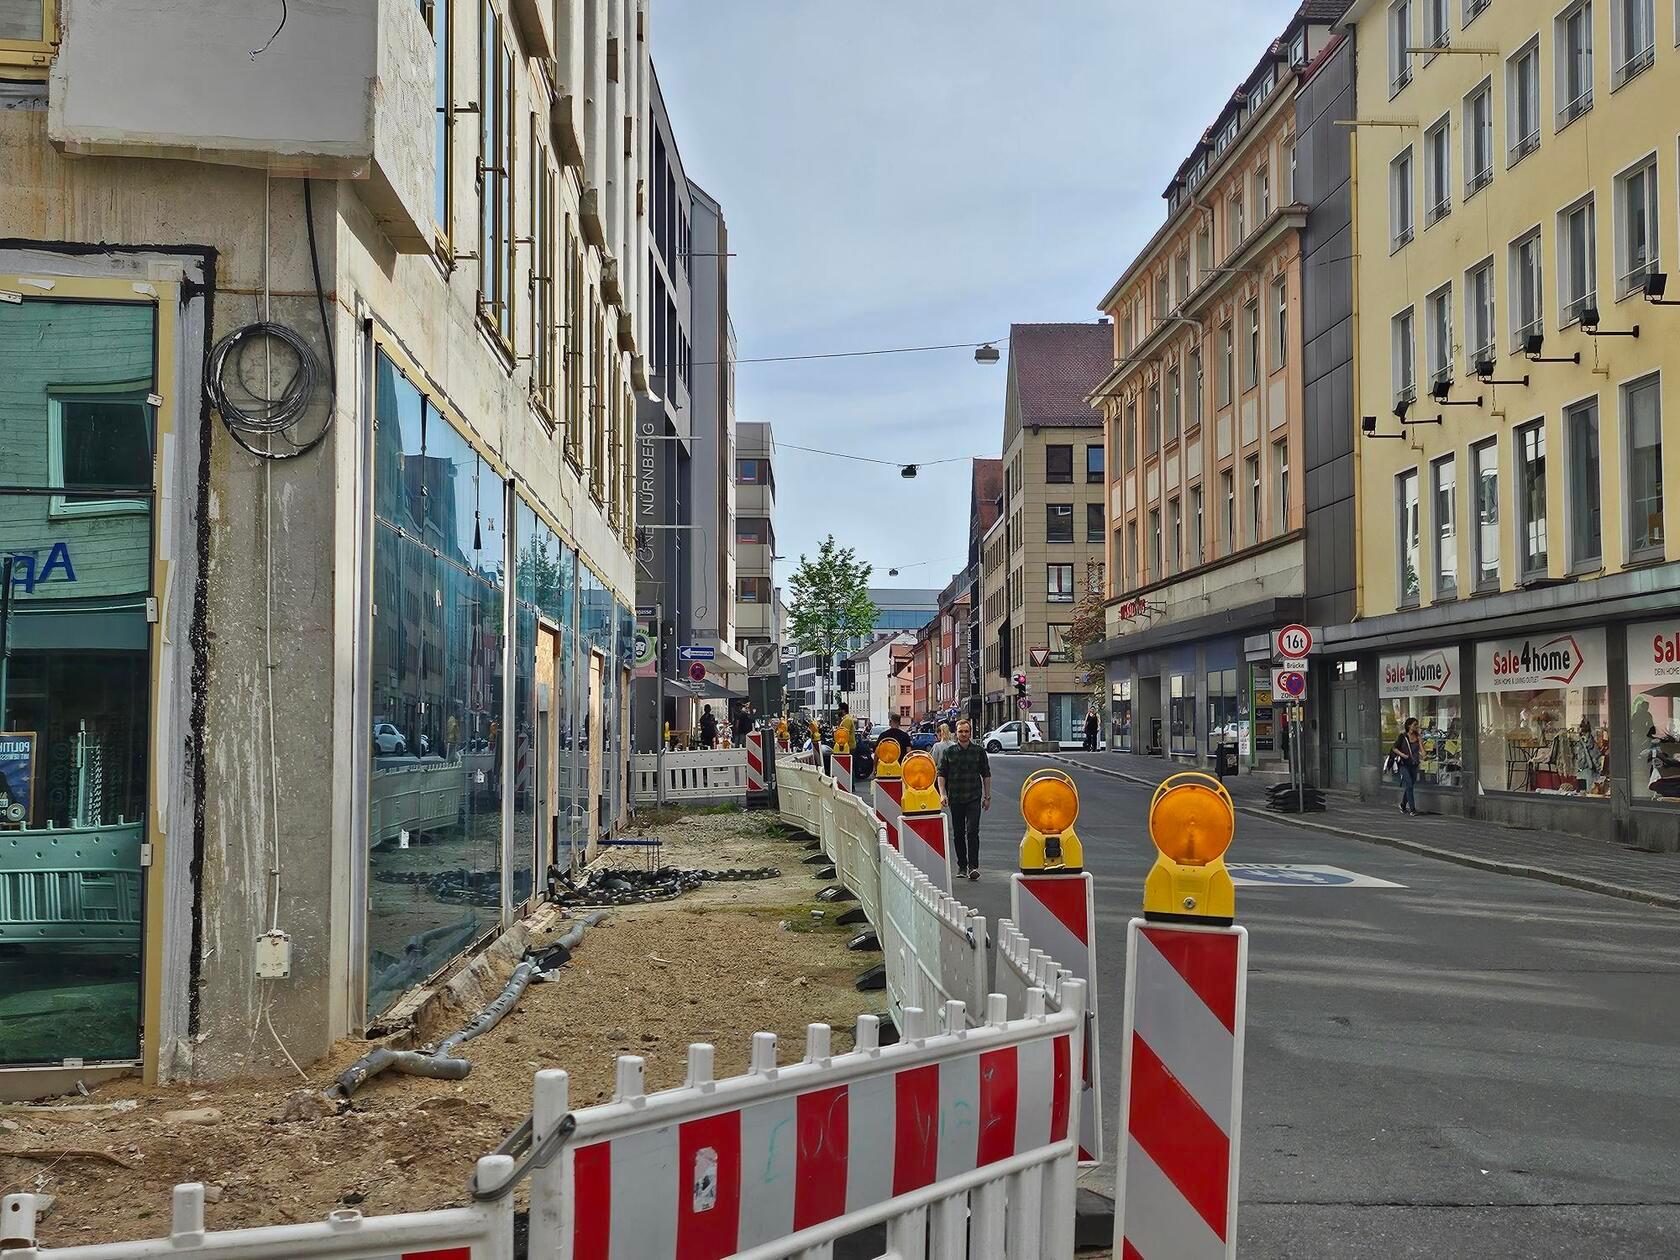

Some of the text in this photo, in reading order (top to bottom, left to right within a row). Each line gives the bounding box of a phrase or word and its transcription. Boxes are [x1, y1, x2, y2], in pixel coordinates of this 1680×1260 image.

[640, 422, 655, 515] NÜRNBERG
[1286, 635, 1304, 649] 16t
[1386, 654, 1442, 683] Sale4home
[1493, 641, 1571, 675] Sale4home
[1654, 668, 1665, 676] DEIN
